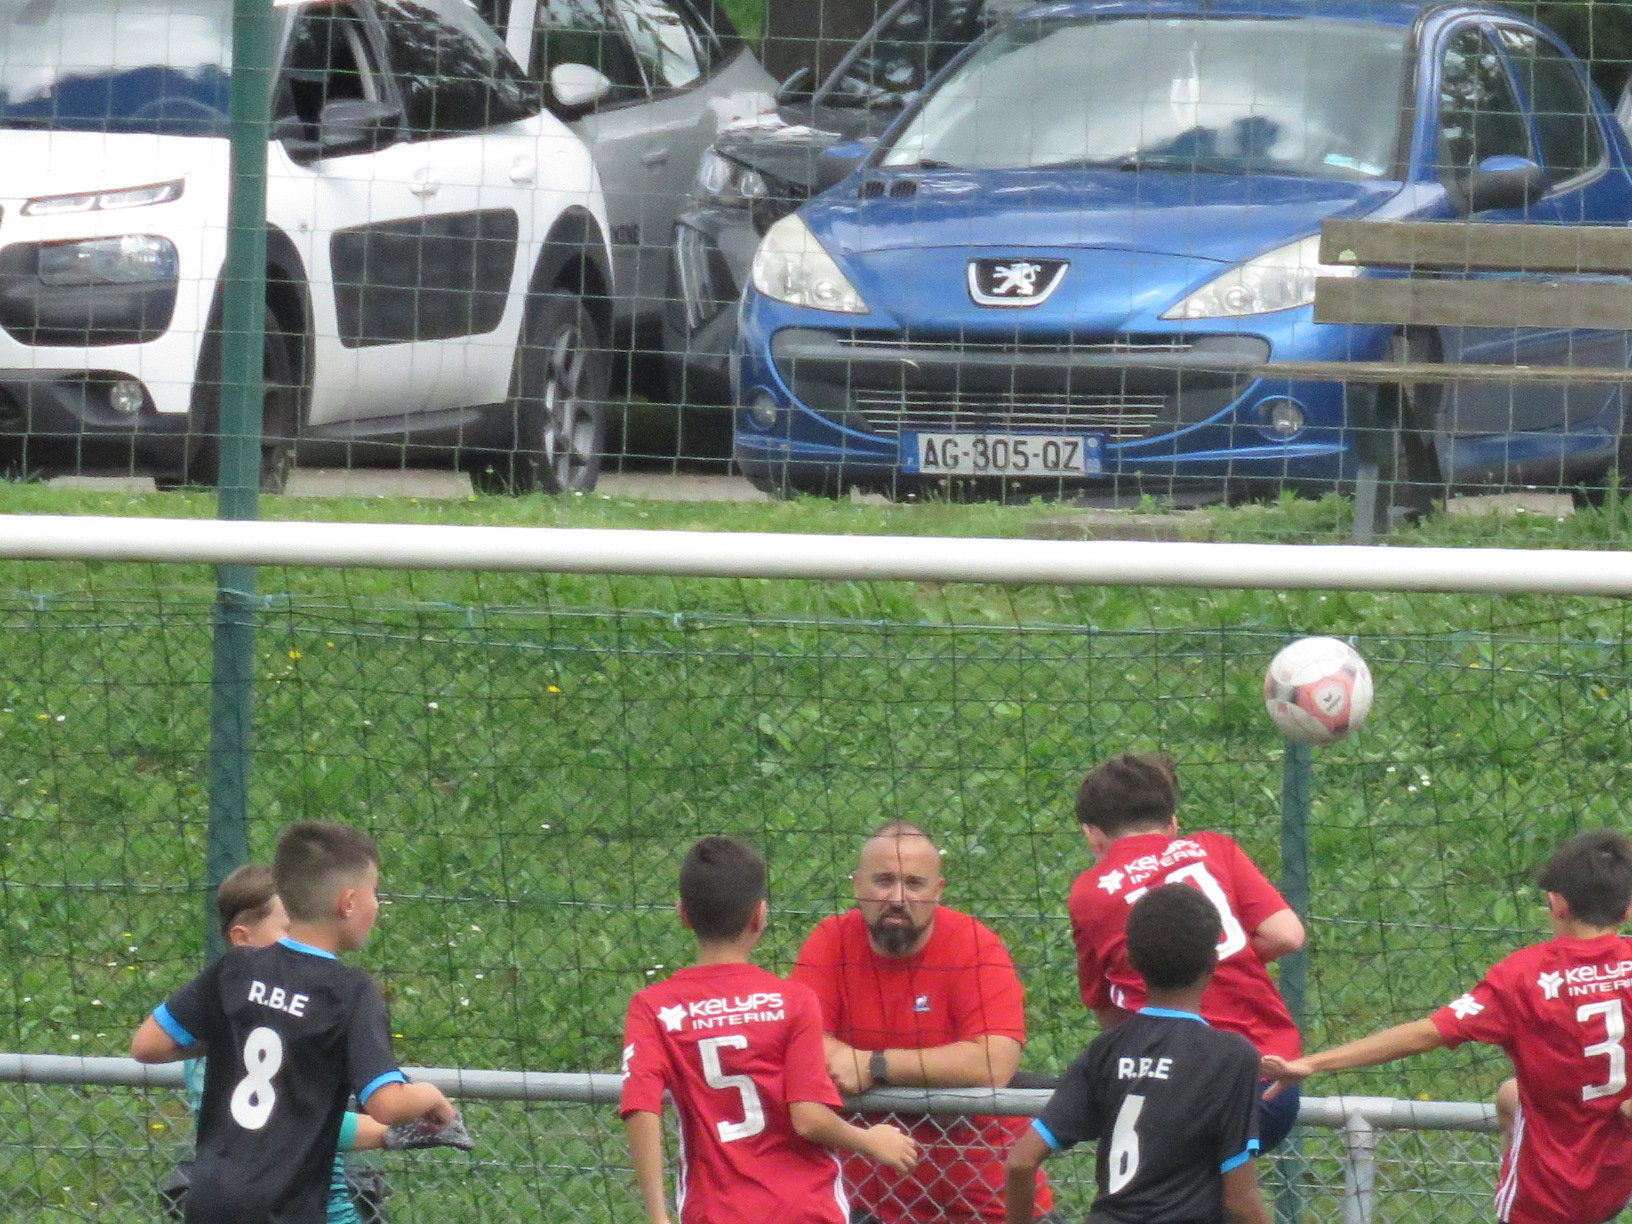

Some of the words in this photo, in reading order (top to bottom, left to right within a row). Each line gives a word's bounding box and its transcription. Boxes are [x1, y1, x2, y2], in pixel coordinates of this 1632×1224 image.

[923, 437, 1081, 472] AG-305-QZ
[247, 980, 309, 1018] R.B.E
[692, 1009, 785, 1030] INTERIM
[230, 1026, 283, 1131] 8
[698, 1034, 766, 1143] 5
[1576, 998, 1627, 1102] 3
[1108, 1094, 1147, 1195] 6
